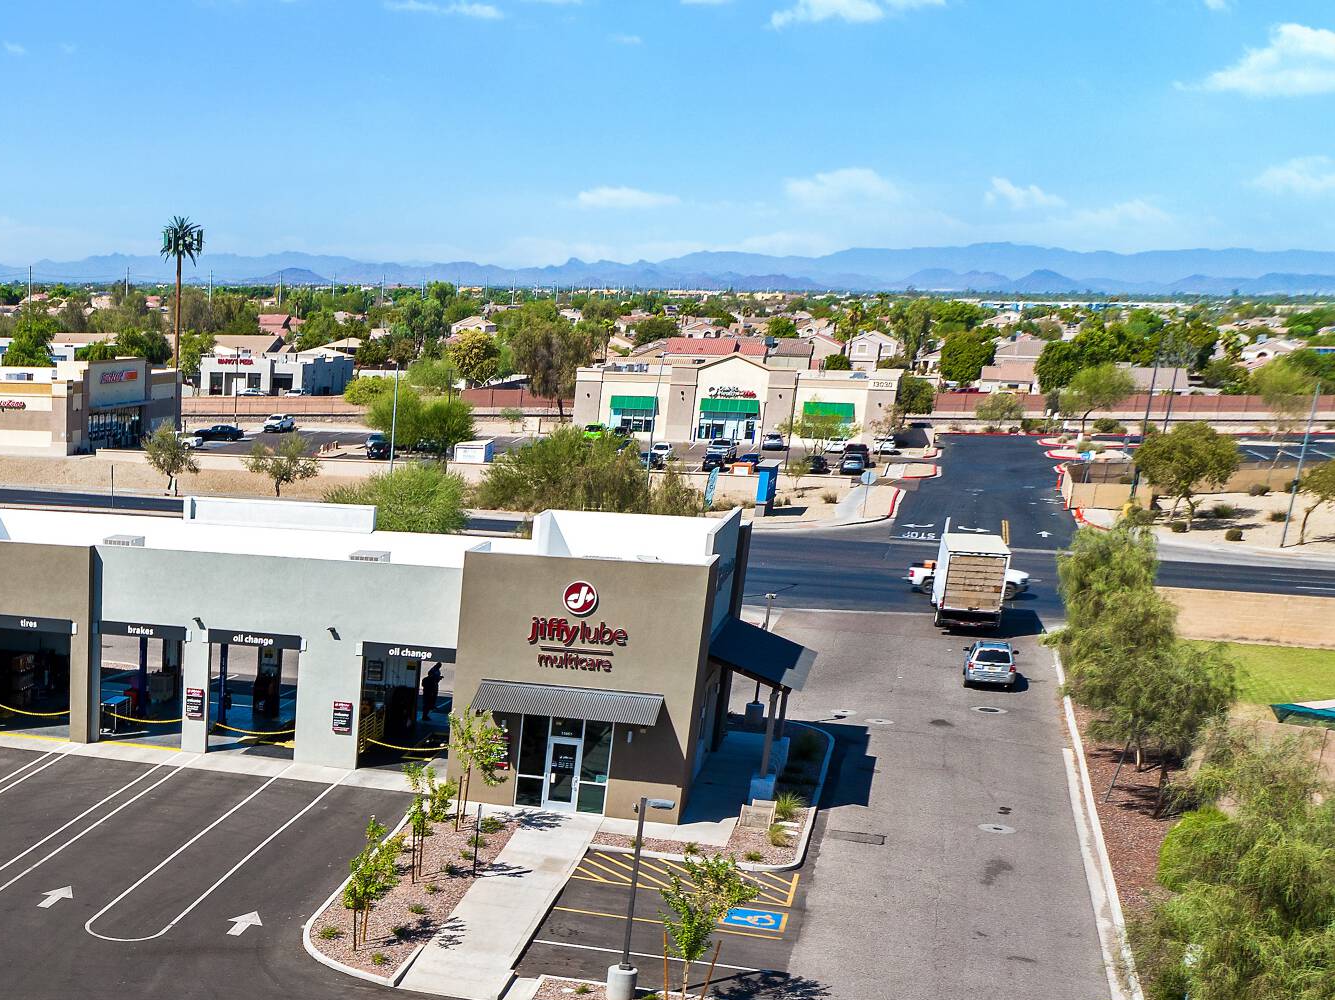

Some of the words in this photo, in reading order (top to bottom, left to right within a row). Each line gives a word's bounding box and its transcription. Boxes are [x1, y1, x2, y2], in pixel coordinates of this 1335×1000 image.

[20, 619, 37, 628] tires
[127, 625, 154, 636] brakes
[527, 617, 579, 646] jiffy
[579, 621, 628, 645] lube
[232, 633, 244, 643] oil
[244, 635, 274, 646] change
[388, 647, 400, 656] oil
[401, 648, 433, 659] change
[537, 652, 612, 672] multicare
